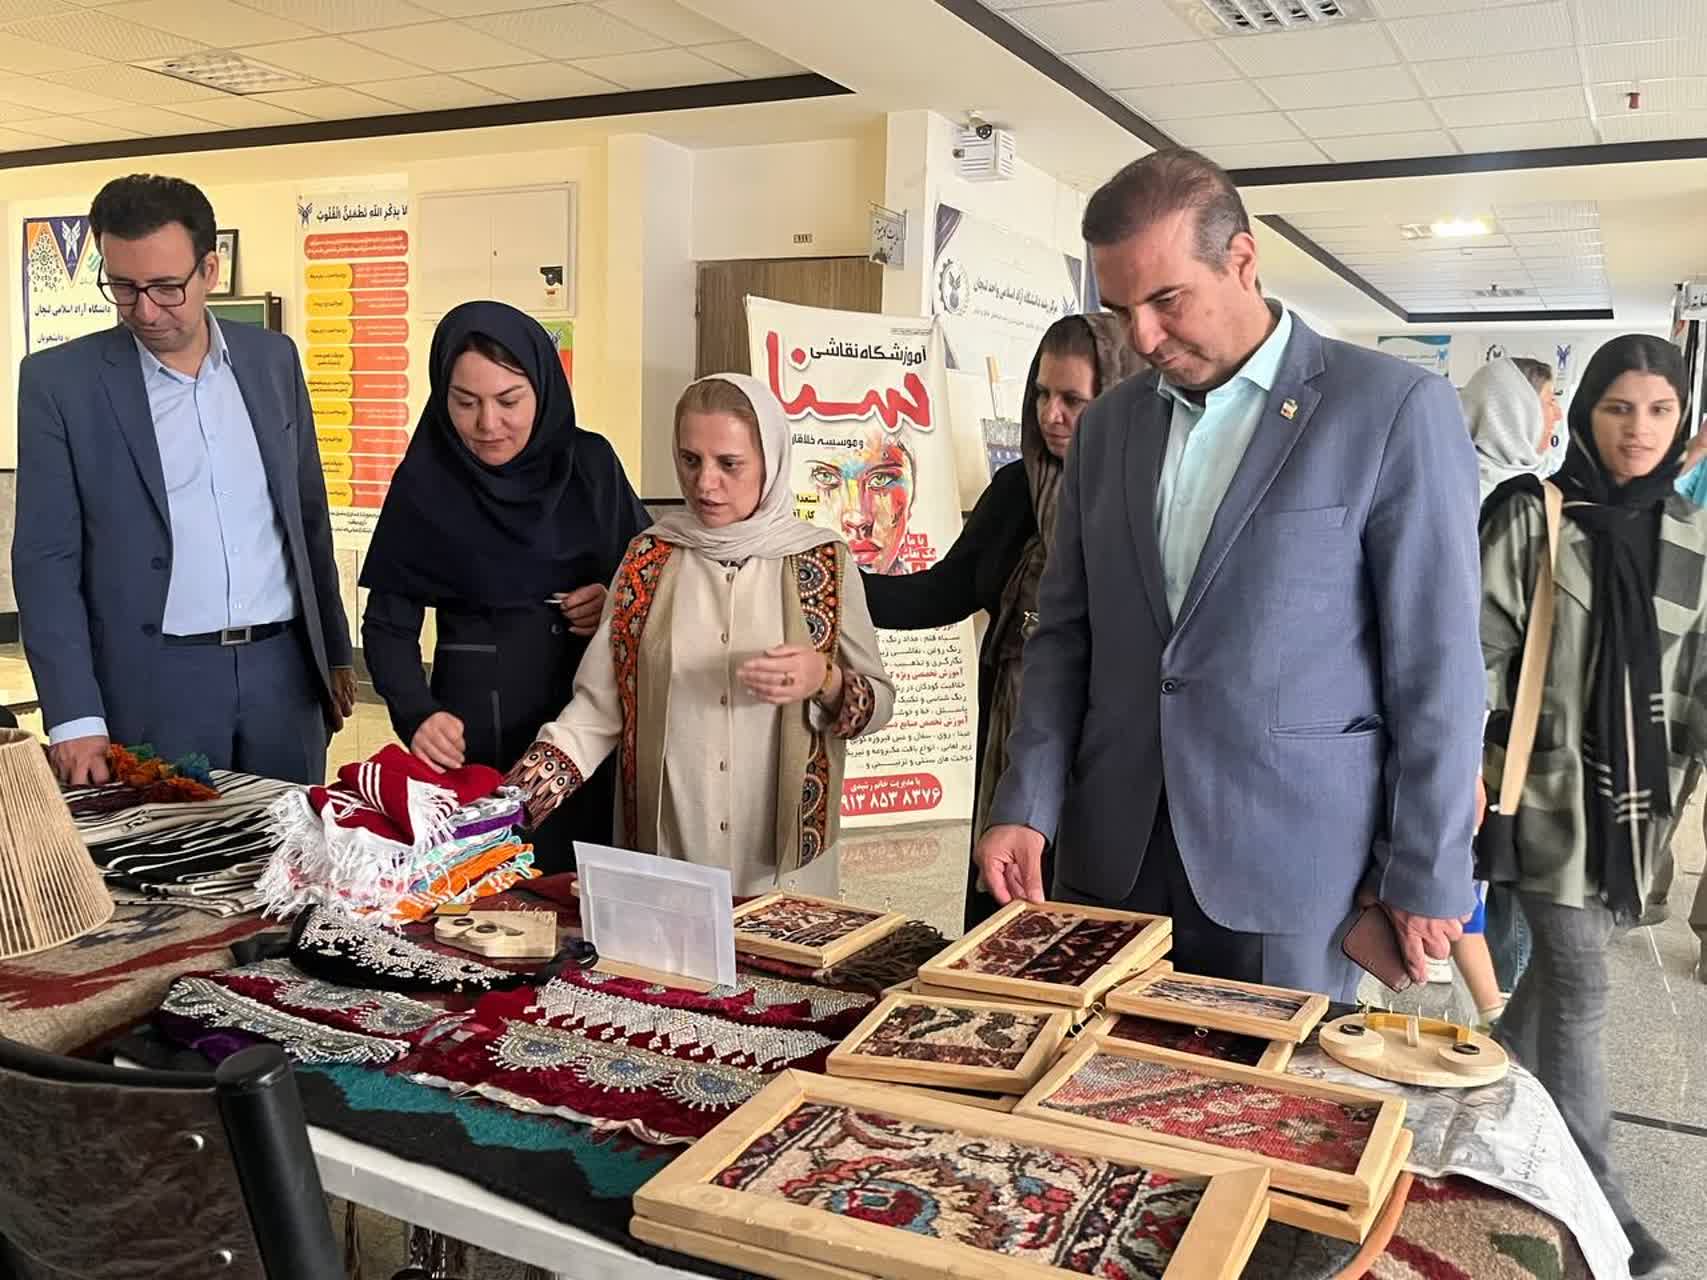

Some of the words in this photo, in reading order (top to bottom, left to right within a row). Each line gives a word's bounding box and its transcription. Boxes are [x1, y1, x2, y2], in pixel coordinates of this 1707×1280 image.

[51, 304, 73, 316] اسلامی
[74, 302, 87, 317] آزاد
[88, 303, 112, 314] دانشگاه
[810, 337, 859, 359] نقاشی
[860, 343, 927, 366] آموزشگاه
[766, 331, 931, 428] سنا
[817, 437, 858, 449] موسسه
[796, 494, 820, 503] استعدا
[946, 644, 961, 654] رنگ
[895, 671, 910, 681] ویژه
[938, 667, 963, 679] آموزش
[915, 682, 938, 693] کودکان
[926, 694, 950, 704] شناسی
[951, 693, 967, 702] رنگ
[944, 714, 968, 727] آموزش
[890, 778, 915, 788] مدیریت
[870, 791, 898, 809] ۸۵۳
[903, 787, 941, 805] ۸۳۷۶
